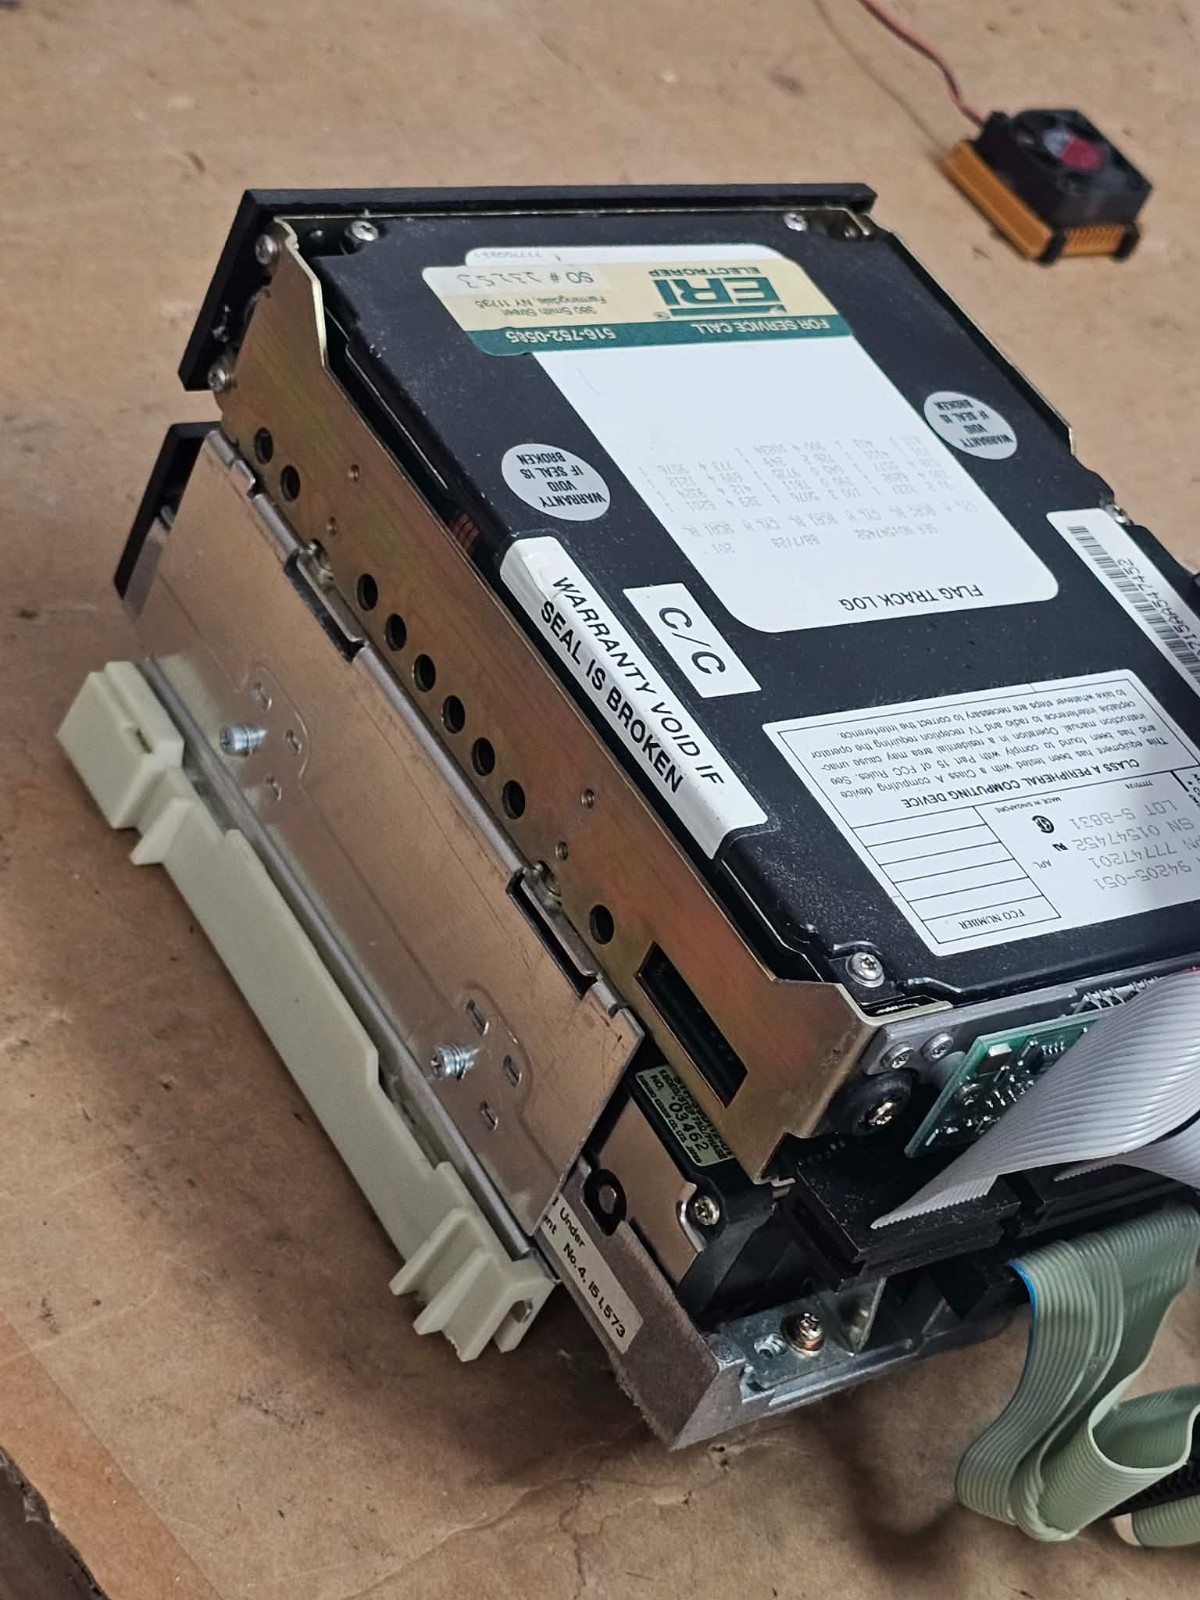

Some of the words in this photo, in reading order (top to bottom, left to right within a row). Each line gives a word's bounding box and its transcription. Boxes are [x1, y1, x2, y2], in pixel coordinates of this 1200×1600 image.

[565, 272, 594, 284] SO
[648, 267, 761, 277] ELECTROREP
[653, 277, 782, 306] ERI
[515, 299, 532, 307] NY
[500, 308, 538, 317] Street
[538, 307, 573, 316] Smith
[690, 323, 733, 334] CALL
[732, 320, 800, 332] SERVICE
[798, 319, 830, 329] FOR
[505, 327, 616, 343] 516-752-0585
[963, 424, 988, 435] VOID
[960, 434, 1013, 448] WARRANTY
[516, 451, 566, 465] BROKEN
[520, 468, 536, 480] IS
[535, 466, 568, 478] SEAL
[569, 465, 584, 476] IF
[547, 480, 577, 492] VOID
[539, 492, 606, 508] WARRANTY
[938, 584, 984, 599] FLAG
[838, 596, 878, 611] LOG
[877, 589, 940, 607] TRACK
[659, 607, 726, 676] C/C
[552, 577, 656, 695] WARRANTY
[650, 701, 701, 757] VOID
[694, 764, 724, 785] IF
[540, 600, 582, 666] SEAL
[586, 659, 606, 691] IS
[605, 685, 683, 794] BROKEN
[1094, 691, 1115, 699] take
[1115, 689, 1127, 697] to
[1029, 700, 1054, 709] steps
[1056, 694, 1094, 705] whatever
[965, 706, 1011, 720] necessary
[1012, 704, 1028, 712] are
[1099, 701, 1136, 713] ceptable
[953, 714, 965, 722] to
[1031, 716, 1043, 724] to
[1044, 707, 1097, 721] interference
[1099, 713, 1146, 726] instruction
[899, 722, 917, 731] the
[916, 716, 952, 728] correct
[983, 722, 1003, 732] and
[1005, 718, 1030, 728] radio
[837, 724, 899, 739] interference.
[920, 728, 965, 742] reception
[968, 725, 984, 735] TV
[1012, 727, 1059, 740] Operation
[1117, 729, 1136, 737] has
[1138, 724, 1156, 734] and
[873, 735, 918, 748] requiring
[999, 735, 1010, 743] in
[1058, 736, 1087, 748] found
[1089, 732, 1114, 741] been
[1146, 737, 1168, 747] This
[855, 743, 873, 752] the
[935, 739, 985, 754] residential
[1005, 744, 1039, 756] comply
[1044, 741, 1055, 749] to
[1095, 740, 1143, 755] equipment
[811, 746, 853, 759] operator
[886, 752, 908, 761] may
[910, 747, 933, 757] area
[979, 751, 1001, 761] with
[1048, 752, 1073, 763] been
[1075, 749, 1094, 758] has
[853, 755, 882, 767] cause
[936, 759, 950, 769] 15
[953, 755, 977, 765] Part
[1015, 757, 1046, 769] tested
[1102, 759, 1139, 772] CLASS
[821, 761, 850, 772] unac-
[892, 765, 917, 777] FCC
[920, 762, 932, 772] of
[991, 763, 1012, 774] with
[1091, 765, 1101, 774] A
[830, 775, 852, 786] See
[855, 769, 889, 780] Rules.
[934, 775, 944, 783] A
[948, 769, 977, 780] Class
[1020, 768, 1092, 787] PERIPHERAL
[876, 776, 930, 792] computing
[948, 780, 1020, 800] COMPUTING
[840, 786, 873, 798] device
[900, 792, 948, 808] DEVICE
[995, 802, 1033, 813] SINGAPORE
[1144, 800, 1178, 816] LOT
[1166, 818, 1194, 832] SN
[1071, 825, 1160, 851] 01547452
[1088, 843, 1177, 869] 77747201
[1093, 861, 1192, 889] 94205-051
[1002, 909, 1025, 920] FCO
[958, 914, 1002, 930] NUMBER
[559, 1207, 586, 1248] Under
